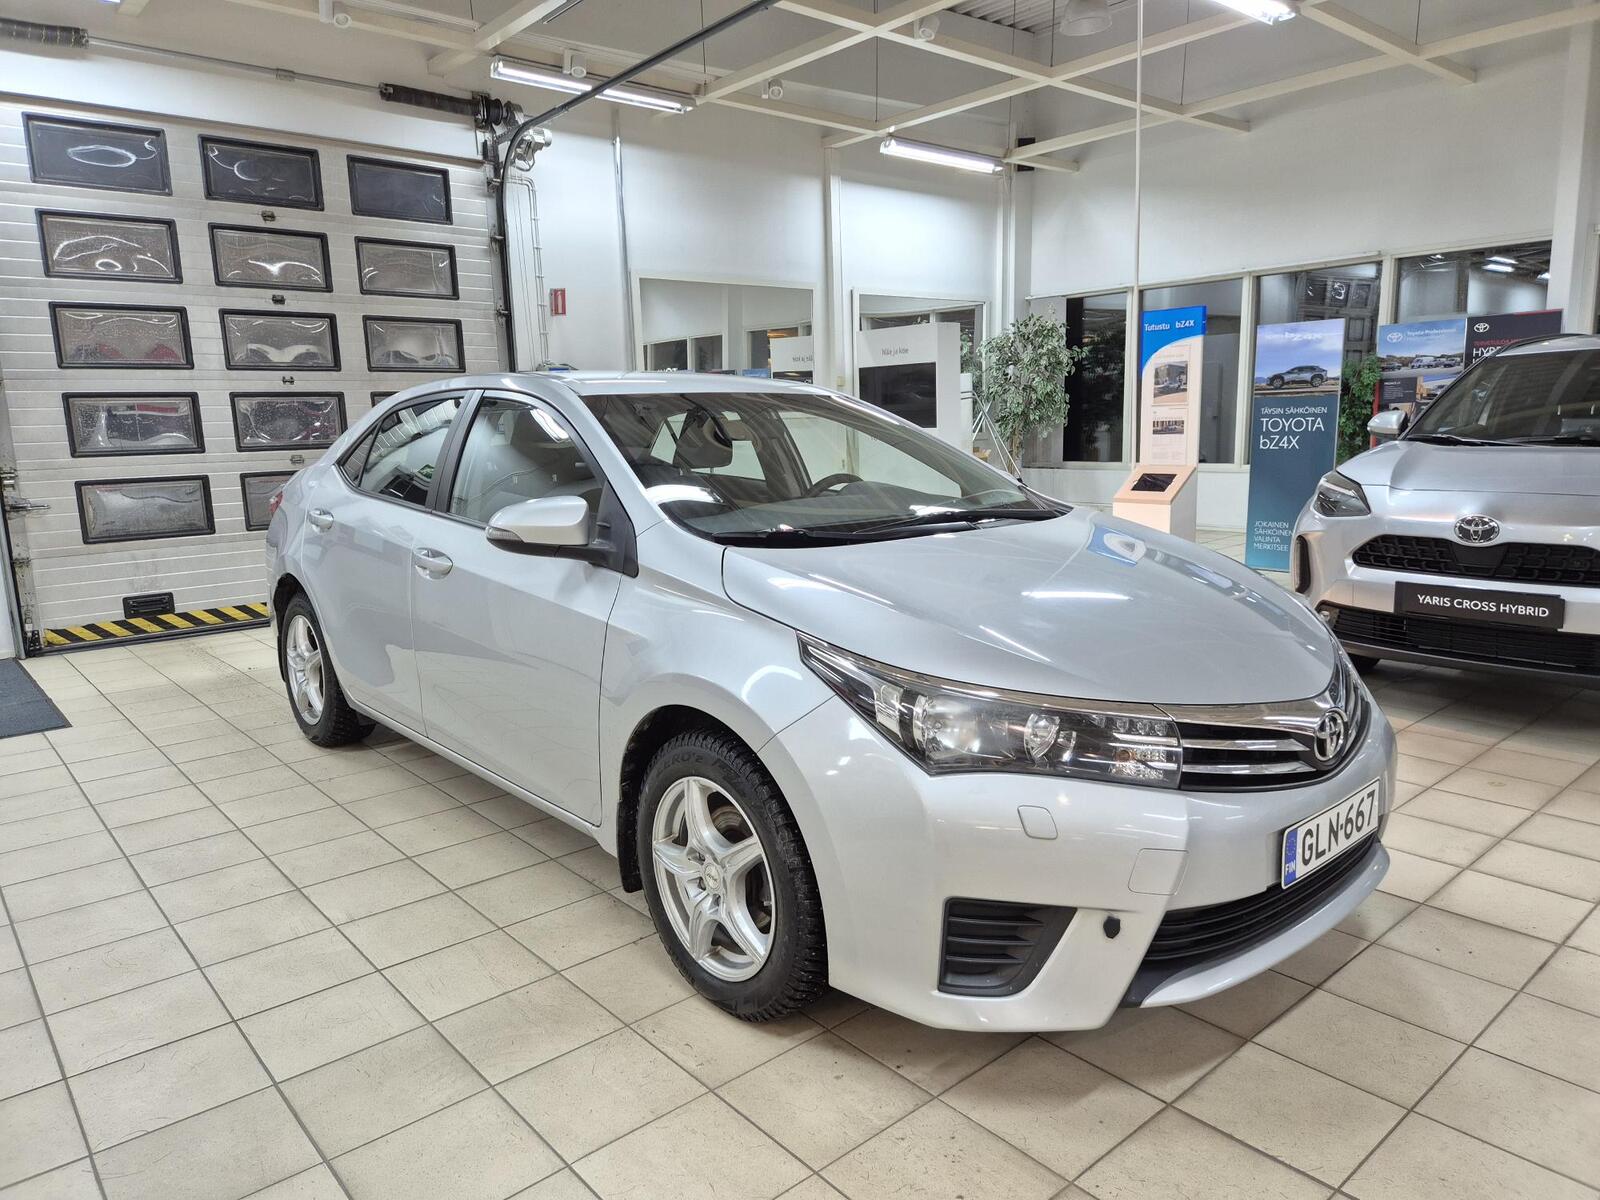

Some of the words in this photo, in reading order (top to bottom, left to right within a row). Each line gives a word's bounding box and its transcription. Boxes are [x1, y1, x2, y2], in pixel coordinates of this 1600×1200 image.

[1144, 322, 1170, 331] Tutustu
[1175, 319, 1195, 328] bZ4X
[1261, 406, 1284, 415] TÄYSIN
[1285, 405, 1328, 415] SÄHKÖINEN
[1260, 417, 1325, 432] TOYOTA
[1259, 435, 1300, 450] bZ4X
[1254, 520, 1289, 528] JOKAINEN
[1253, 535, 1281, 543] VALINTA
[1253, 543, 1289, 552] MERKITSEE
[1417, 594, 1451, 607] YARIS
[1453, 599, 1497, 612] CROSS
[1499, 603, 1550, 618] HYBRID
[1301, 789, 1376, 866] GLN-667
[1285, 860, 1296, 875] FIN
